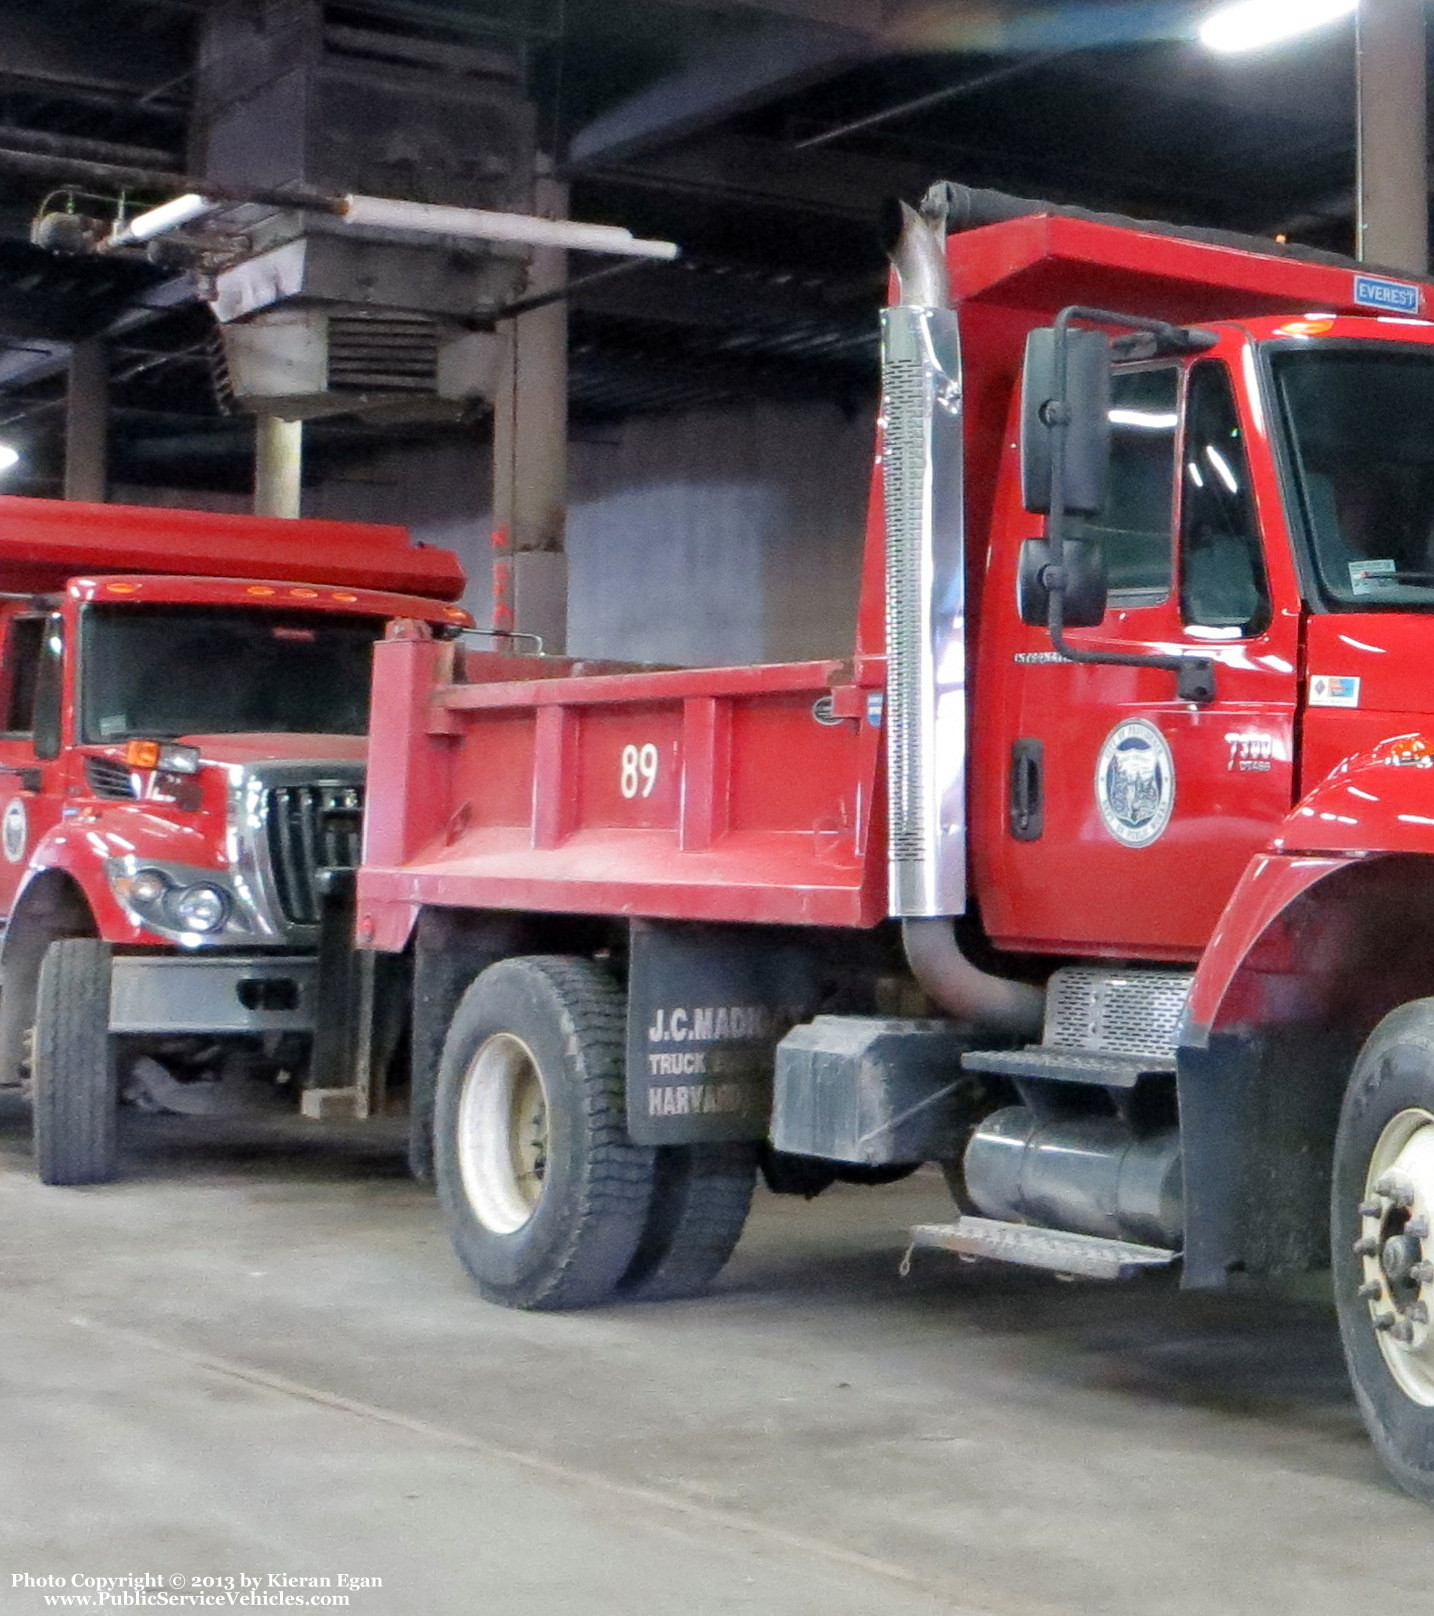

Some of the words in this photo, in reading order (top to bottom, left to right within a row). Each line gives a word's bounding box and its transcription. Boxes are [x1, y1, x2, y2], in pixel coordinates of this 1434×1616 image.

[1359, 283, 1415, 307] EVEREST
[621, 742, 658, 799] 89
[650, 1052, 707, 1075] TRUCK
